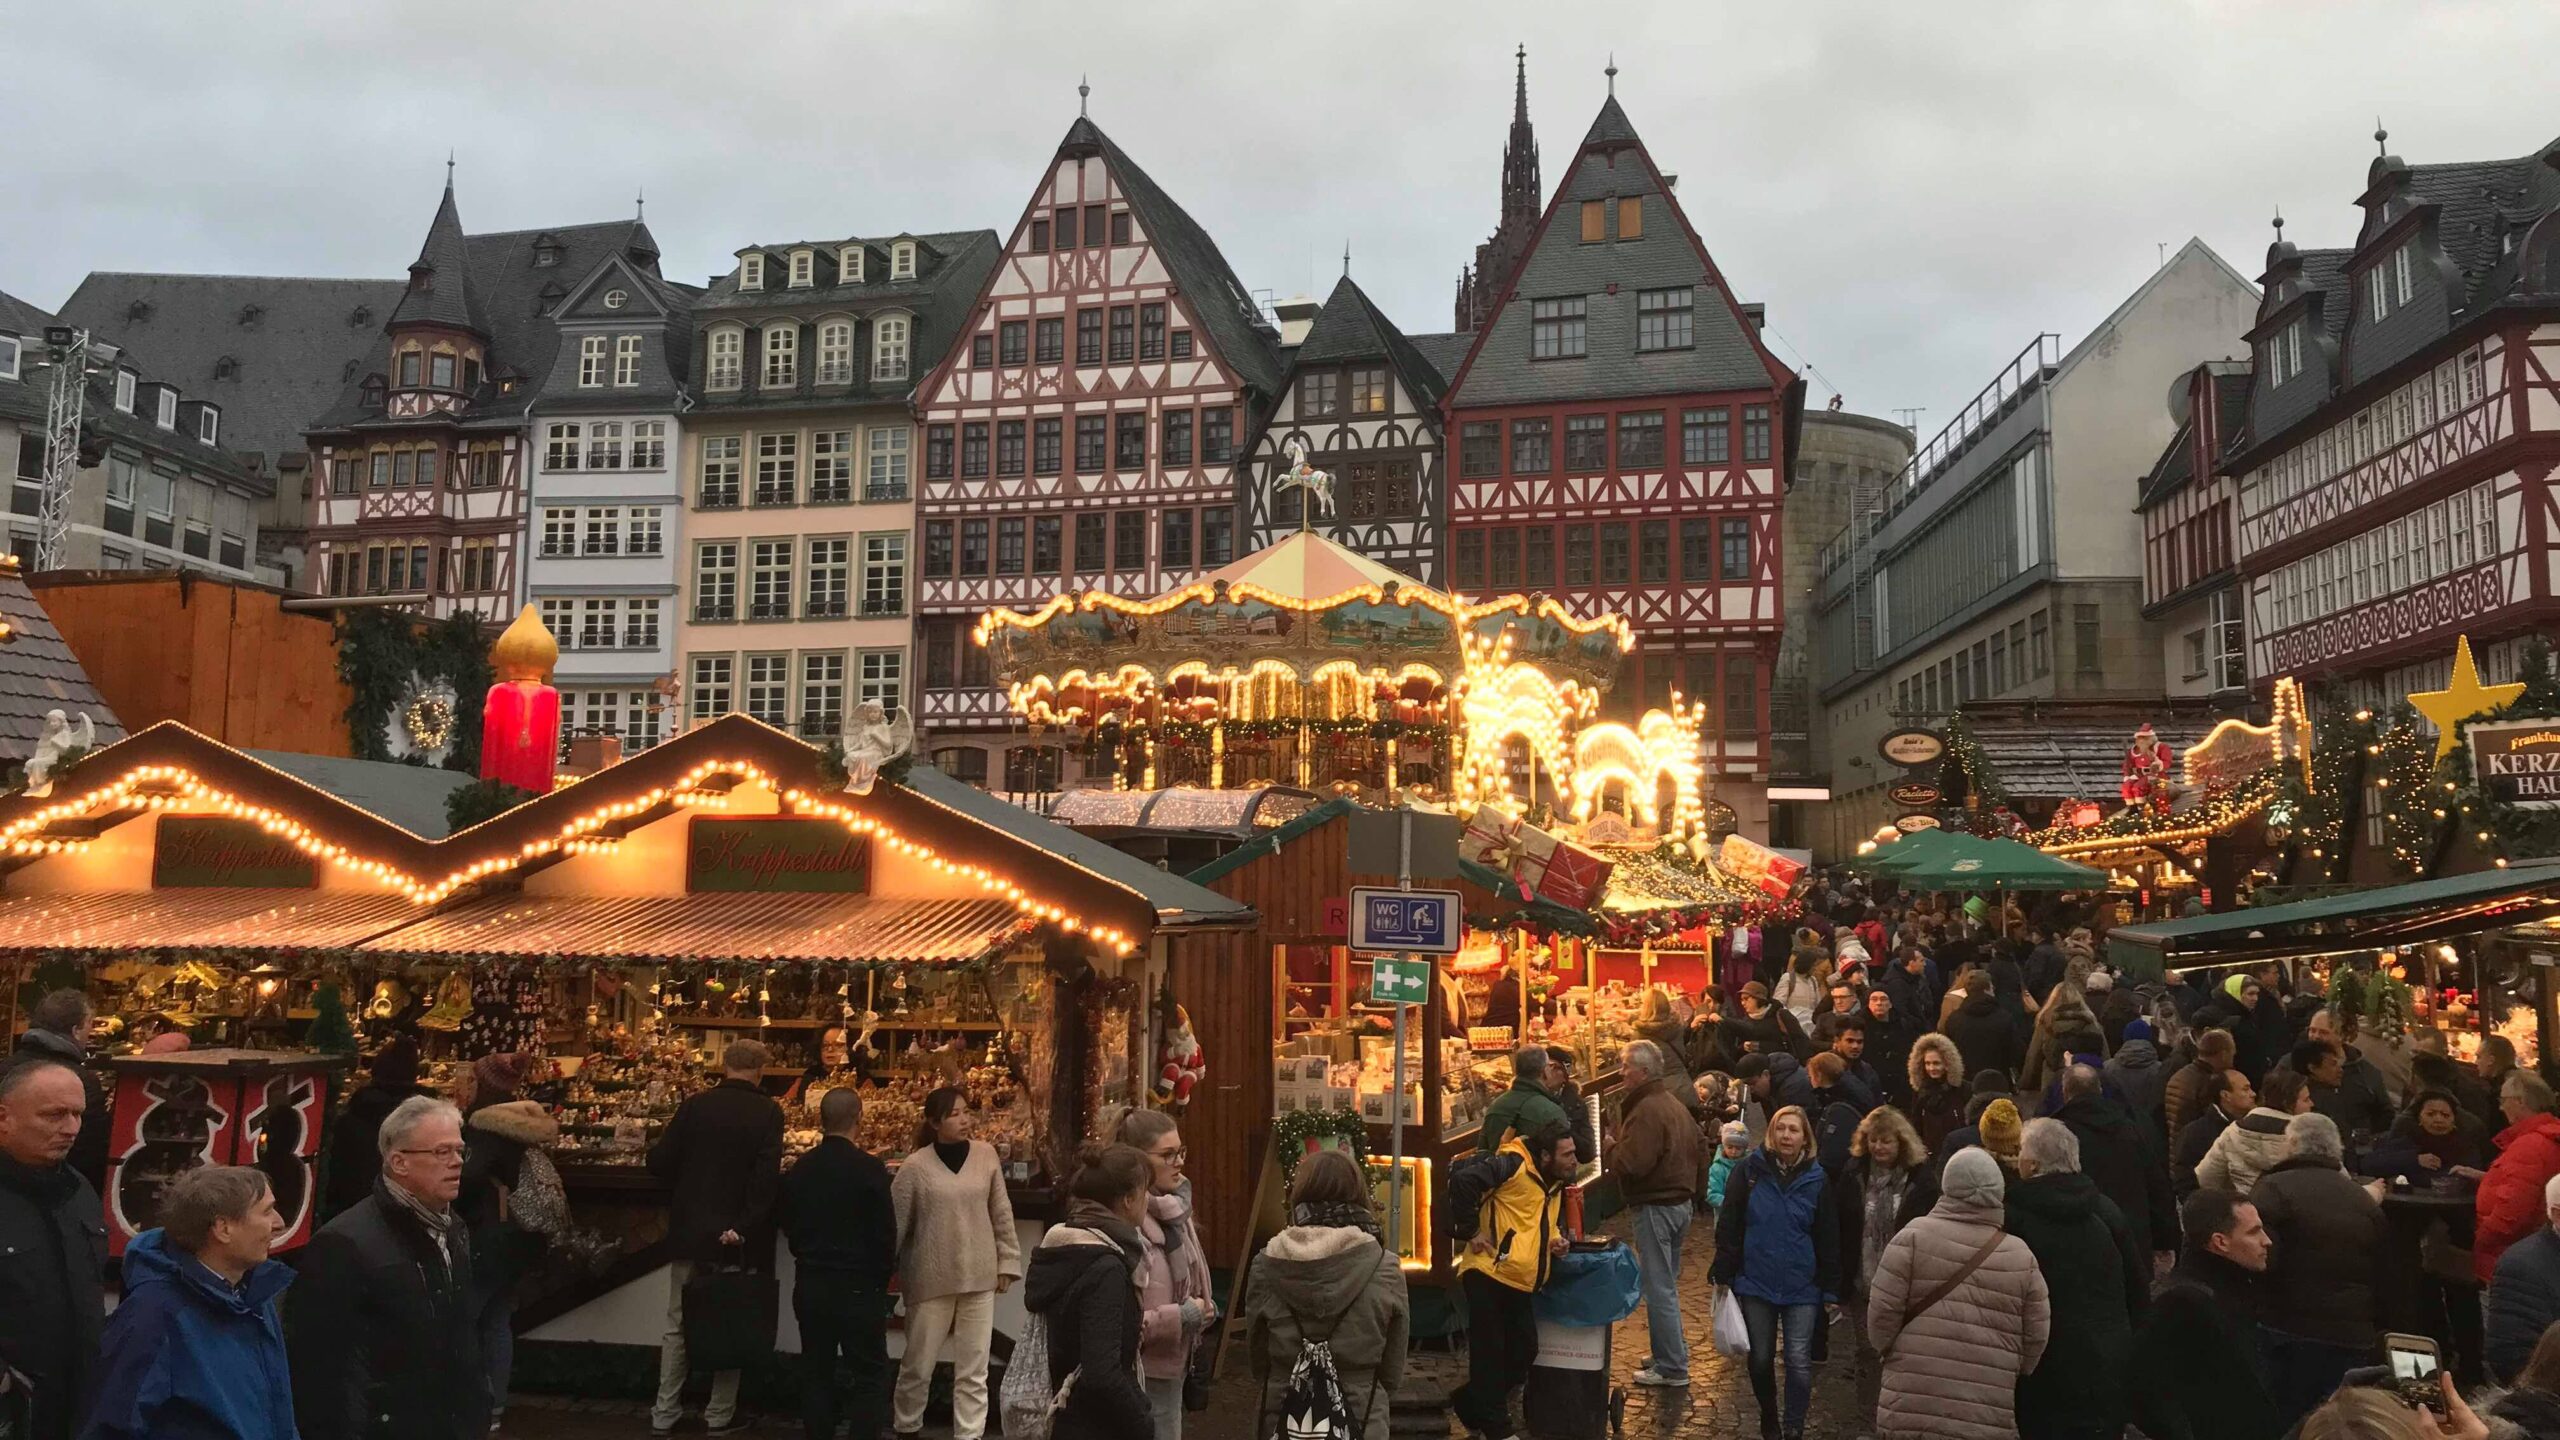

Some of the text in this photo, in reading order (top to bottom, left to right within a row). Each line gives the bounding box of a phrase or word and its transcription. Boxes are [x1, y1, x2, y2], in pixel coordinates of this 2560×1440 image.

[2488, 753, 2560, 775] KERZ
[2517, 776, 2560, 795] HAU
[1376, 903, 1400, 915] WC
